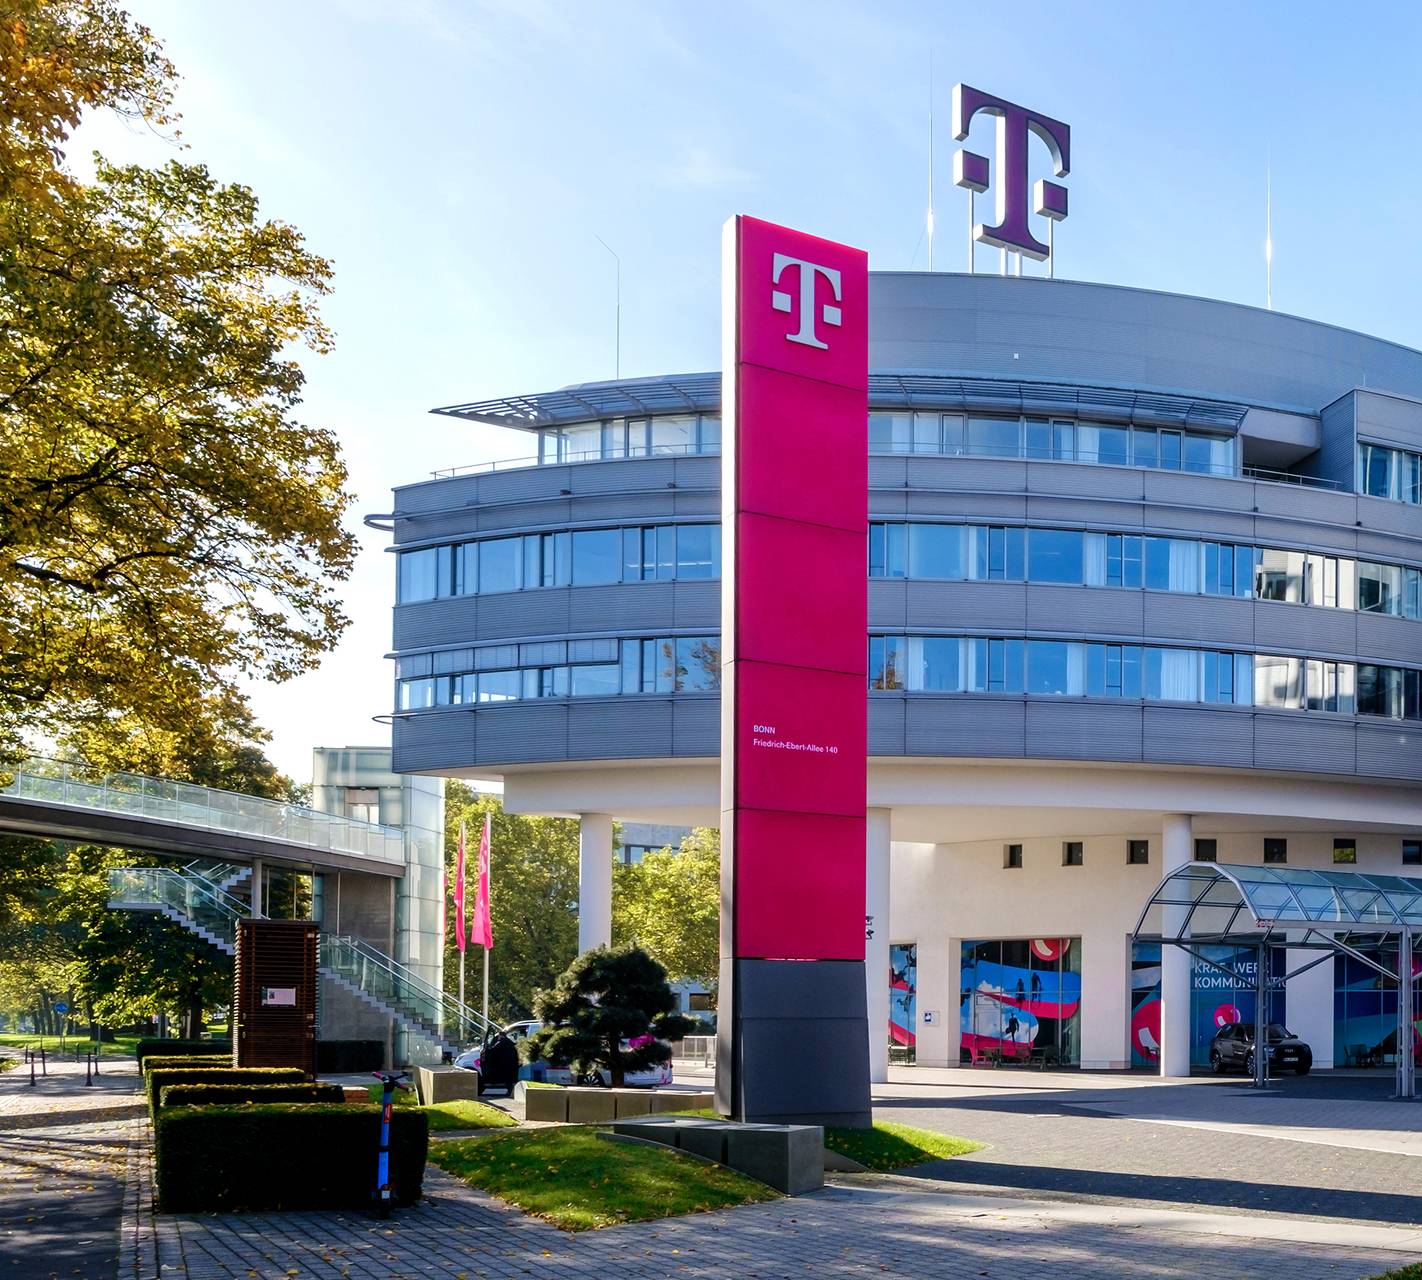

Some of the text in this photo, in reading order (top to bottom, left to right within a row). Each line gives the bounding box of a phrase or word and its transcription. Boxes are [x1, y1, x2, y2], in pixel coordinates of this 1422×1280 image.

[952, 83, 1071, 262] T
[772, 252, 842, 350] T
[753, 724, 776, 734] BONN
[753, 738, 838, 754] Friedrich-Ebert-Allee 140
